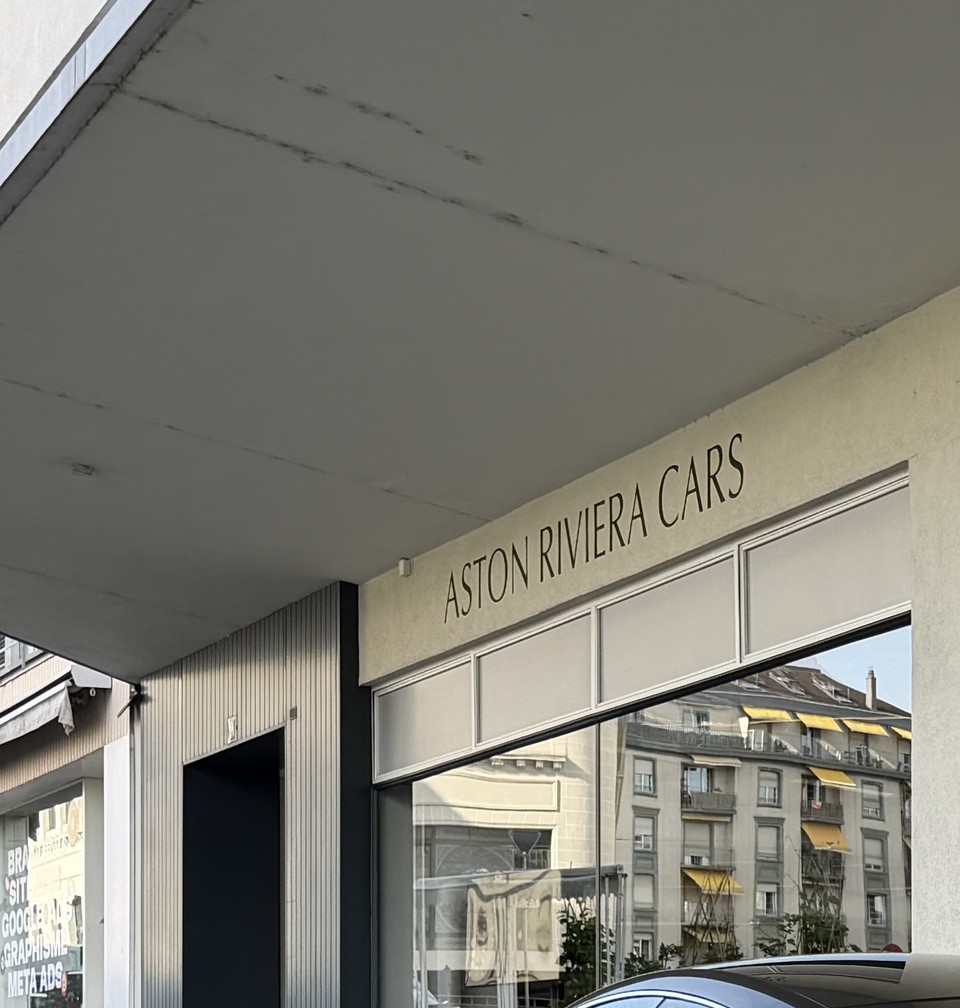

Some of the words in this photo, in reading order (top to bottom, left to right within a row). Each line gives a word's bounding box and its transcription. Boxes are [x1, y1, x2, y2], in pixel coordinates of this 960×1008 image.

[444, 535, 530, 624] ASTON
[539, 482, 648, 583] RIVIERA
[658, 432, 745, 528] CARS
[4, 932, 68, 968] GRAPHISME
[8, 967, 38, 998] META
[39, 961, 64, 992] ADS
